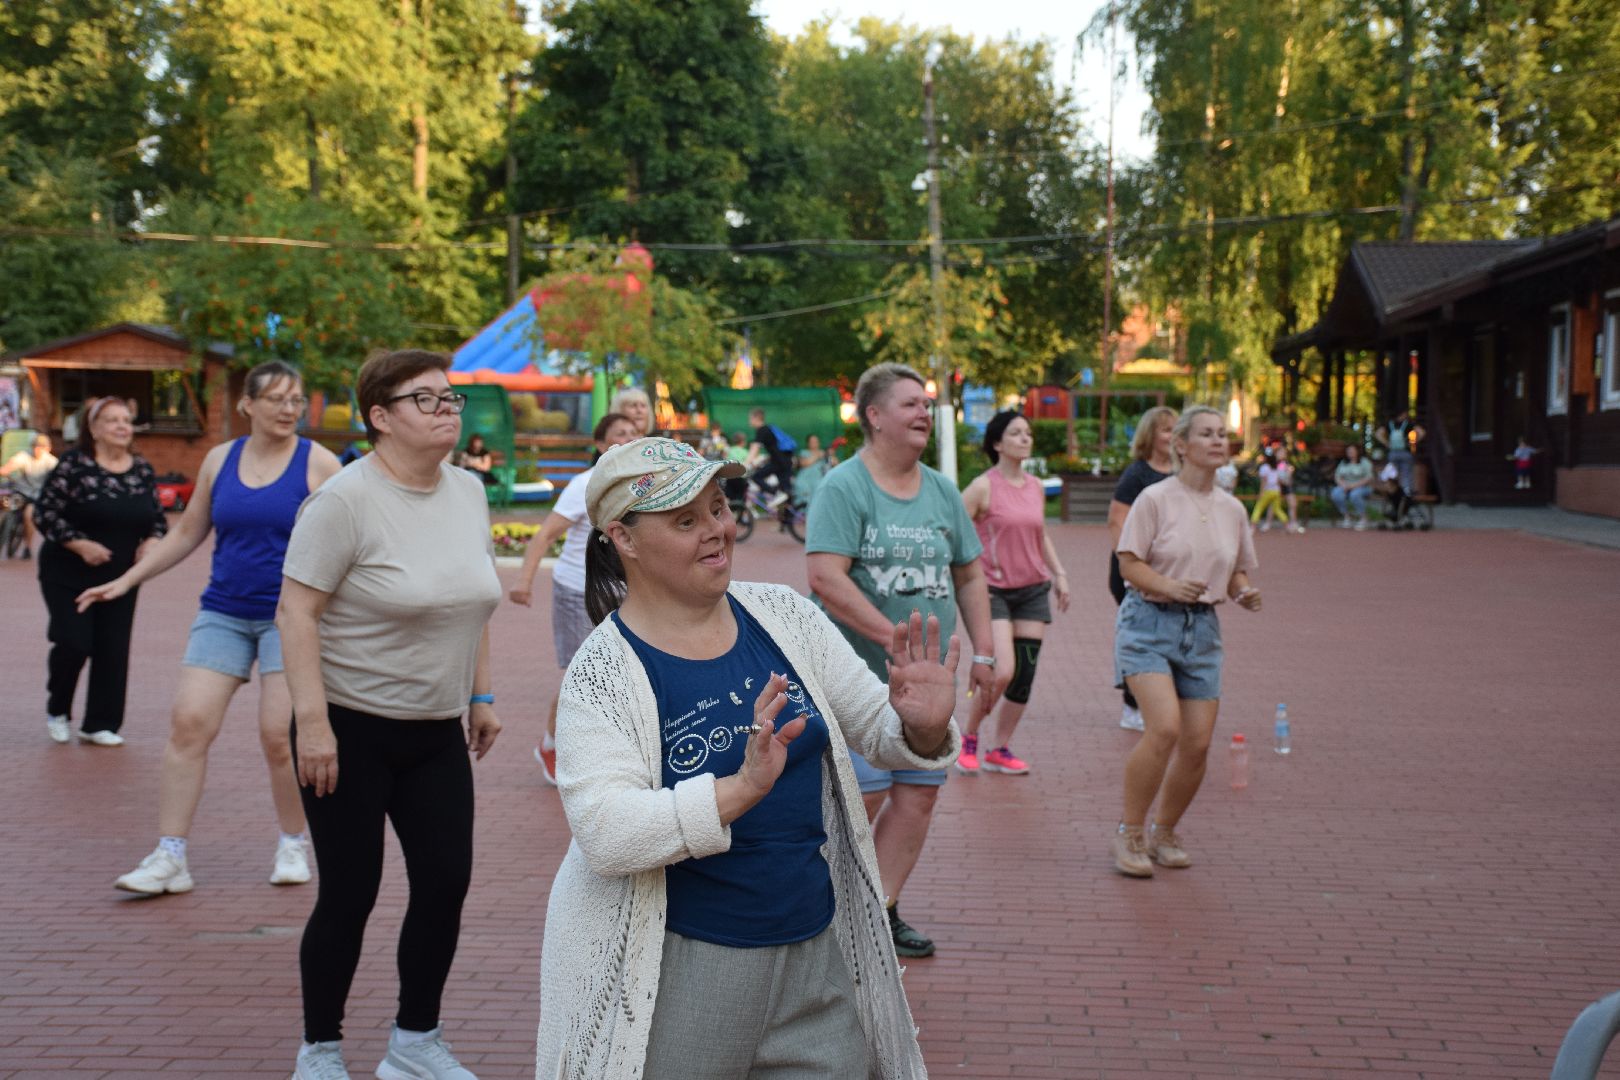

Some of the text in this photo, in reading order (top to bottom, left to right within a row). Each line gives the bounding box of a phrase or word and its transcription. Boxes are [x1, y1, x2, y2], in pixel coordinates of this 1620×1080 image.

[886, 523, 935, 543] thought
[860, 541, 935, 561] the day is
